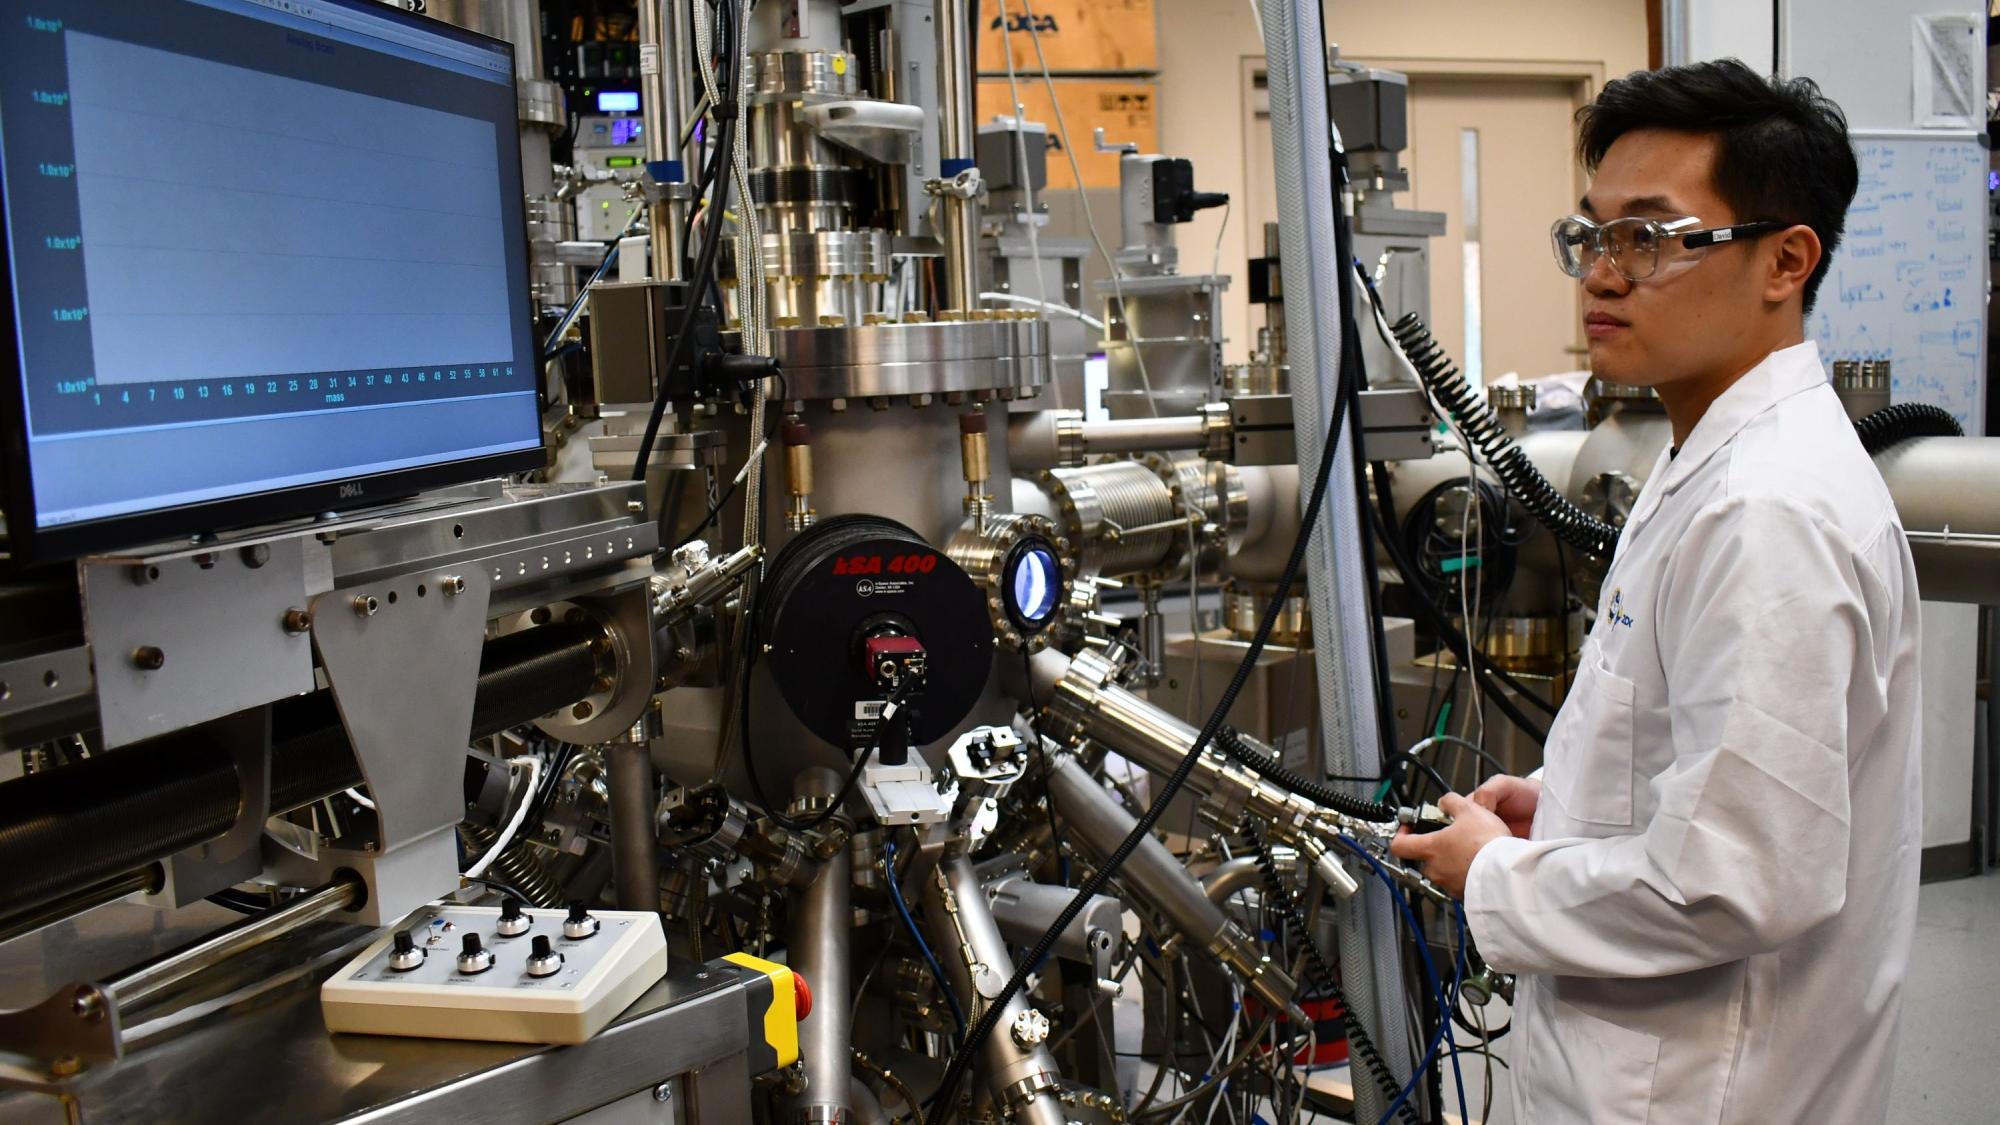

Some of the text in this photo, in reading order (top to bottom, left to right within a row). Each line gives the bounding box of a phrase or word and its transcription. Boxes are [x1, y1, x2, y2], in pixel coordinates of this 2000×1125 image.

[95, 393, 100, 406] 1
[122, 391, 129, 403] 4
[149, 388, 155, 401] 7
[174, 387, 184, 400] 10
[199, 386, 208, 398] 13
[223, 384, 232, 396] 16
[245, 383, 255, 395] 19
[267, 382, 277, 393] 22
[289, 381, 298, 391] 25
[309, 379, 318, 390] 28
[329, 378, 337, 388] 31
[348, 376, 356, 387] 34
[366, 375, 375, 386] 37
[384, 374, 392, 385] 40
[401, 373, 409, 383] 43
[449, 370, 457, 380] 52
[464, 369, 471, 379] 55
[325, 393, 345, 403] mass
[340, 483, 363, 498] DELL
[832, 554, 937, 575] kSA 400
